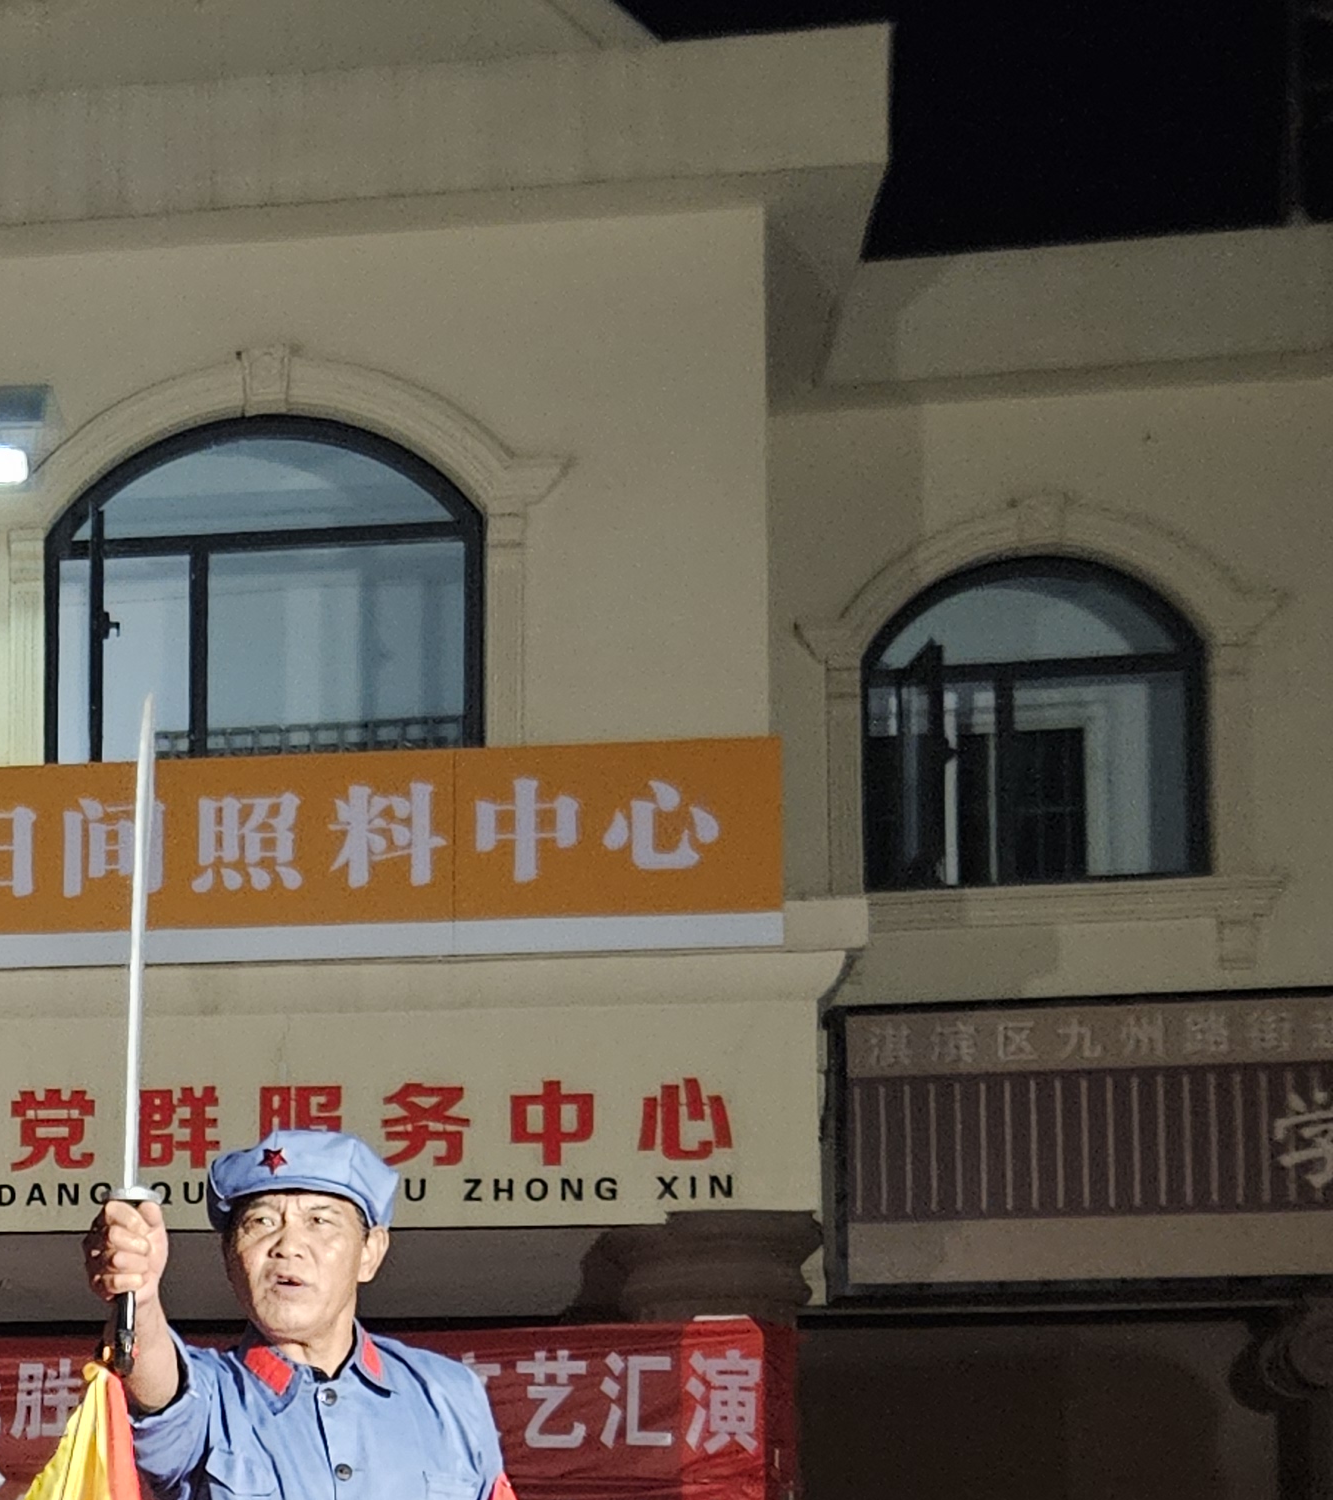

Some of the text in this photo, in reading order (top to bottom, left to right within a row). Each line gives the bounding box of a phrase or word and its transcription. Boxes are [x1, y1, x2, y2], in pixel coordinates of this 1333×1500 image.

[149, 1181, 205, 1206] QU
[404, 1178, 428, 1202] U
[463, 1176, 619, 1202] ZHONG
[656, 1174, 734, 1200] XIN
